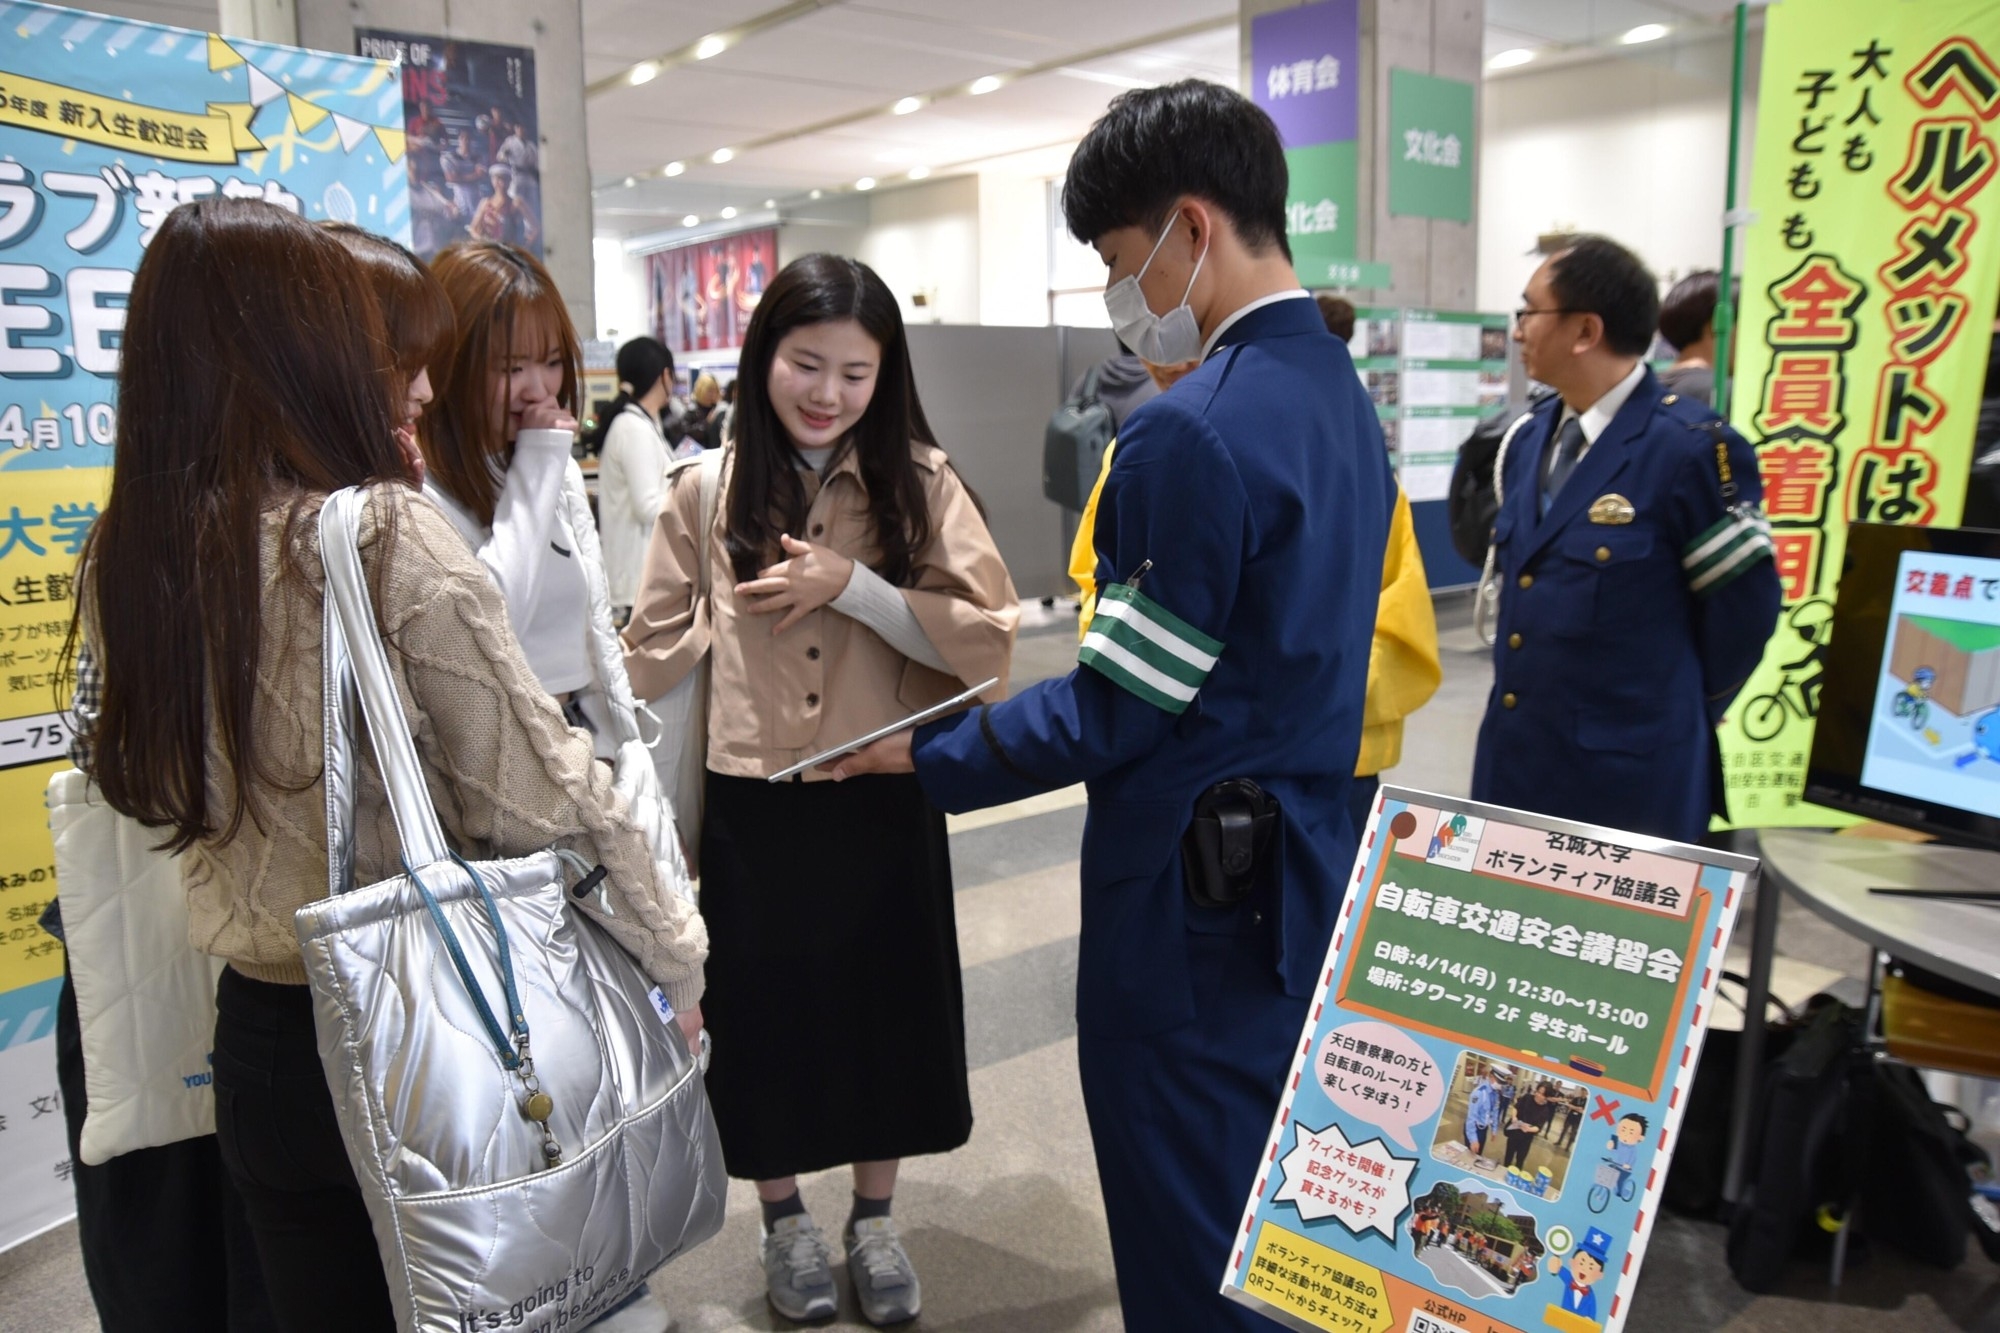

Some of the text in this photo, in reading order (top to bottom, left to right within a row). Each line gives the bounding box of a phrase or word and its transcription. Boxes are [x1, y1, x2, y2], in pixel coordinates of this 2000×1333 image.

[360, 37, 431, 67] PRIDE OF
[1267, 54, 1340, 98] 体育会
[58, 100, 208, 151] 新入生歓迎会
[1842, 40, 1893, 172] 大人も
[1404, 127, 1461, 167] 文化会
[1782, 71, 1839, 249] 子どもも
[1285, 198, 1338, 236] 化会
[1850, 40, 2000, 526] ヘルメットは
[1759, 258, 1857, 602] 全員着用
[1546, 831, 1632, 863] 名城大学
[1485, 849, 1681, 909] ボランティア協議会
[1374, 881, 1683, 983] 自転車交通安全講習会
[1330, 1032, 1433, 1076] 天白警察署の方と
[1495, 1002, 1521, 1023] 2F
[1528, 1011, 1629, 1055] 学生ホール
[1323, 1052, 1427, 1097] 自転車のルールを
[1306, 1159, 1387, 1200] 記念グッズが
[509, 1277, 569, 1326] going
[573, 1265, 595, 1287] to
[1255, 1255, 1379, 1320] 詳細な活動や加入方法は
[1266, 1242, 1378, 1298] ボランティア協議会の
[1423, 1299, 1467, 1324] 公式HP
